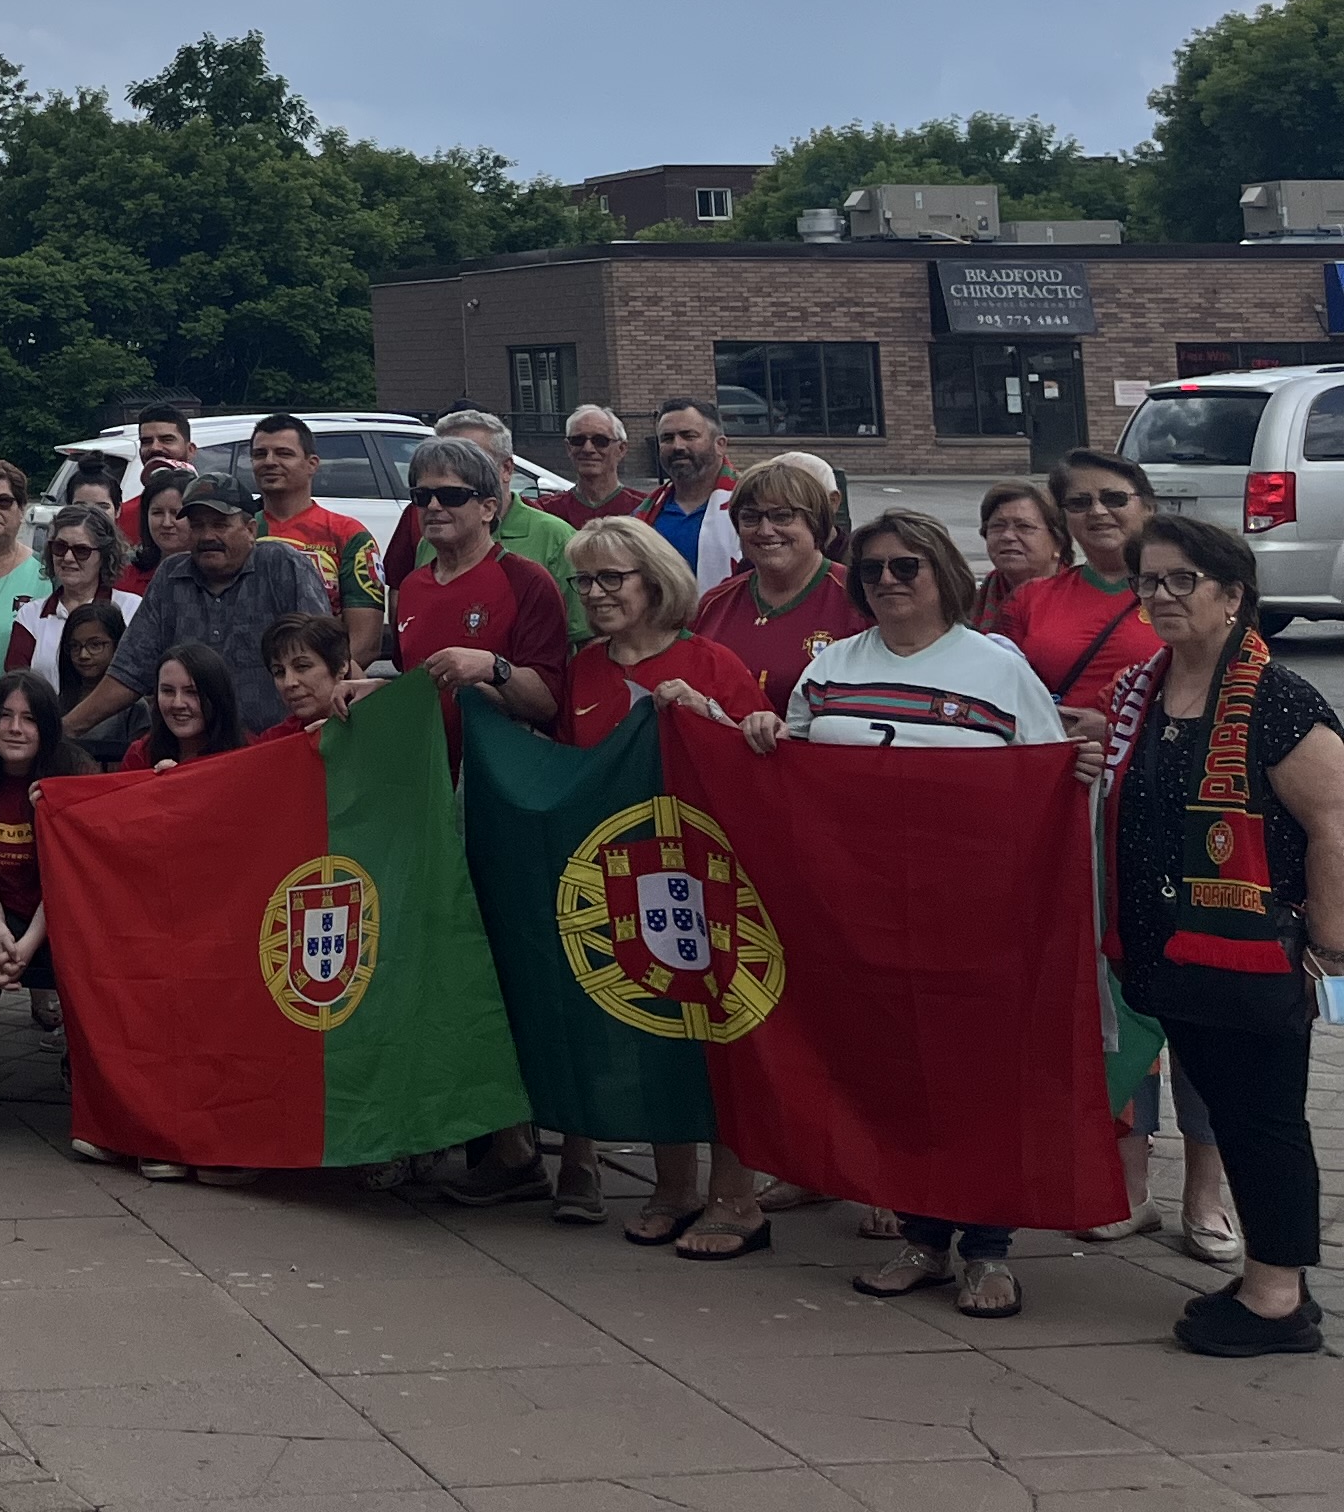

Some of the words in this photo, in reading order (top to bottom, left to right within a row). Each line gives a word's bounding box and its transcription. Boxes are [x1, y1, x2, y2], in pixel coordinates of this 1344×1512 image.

[964, 268, 1063, 283] BRADFORD
[950, 284, 1084, 299] CHIROPRACTIC
[977, 314, 1001, 326] 905
[1006, 315, 1031, 325] 775
[1191, 882, 1267, 915] PORTUGAL
